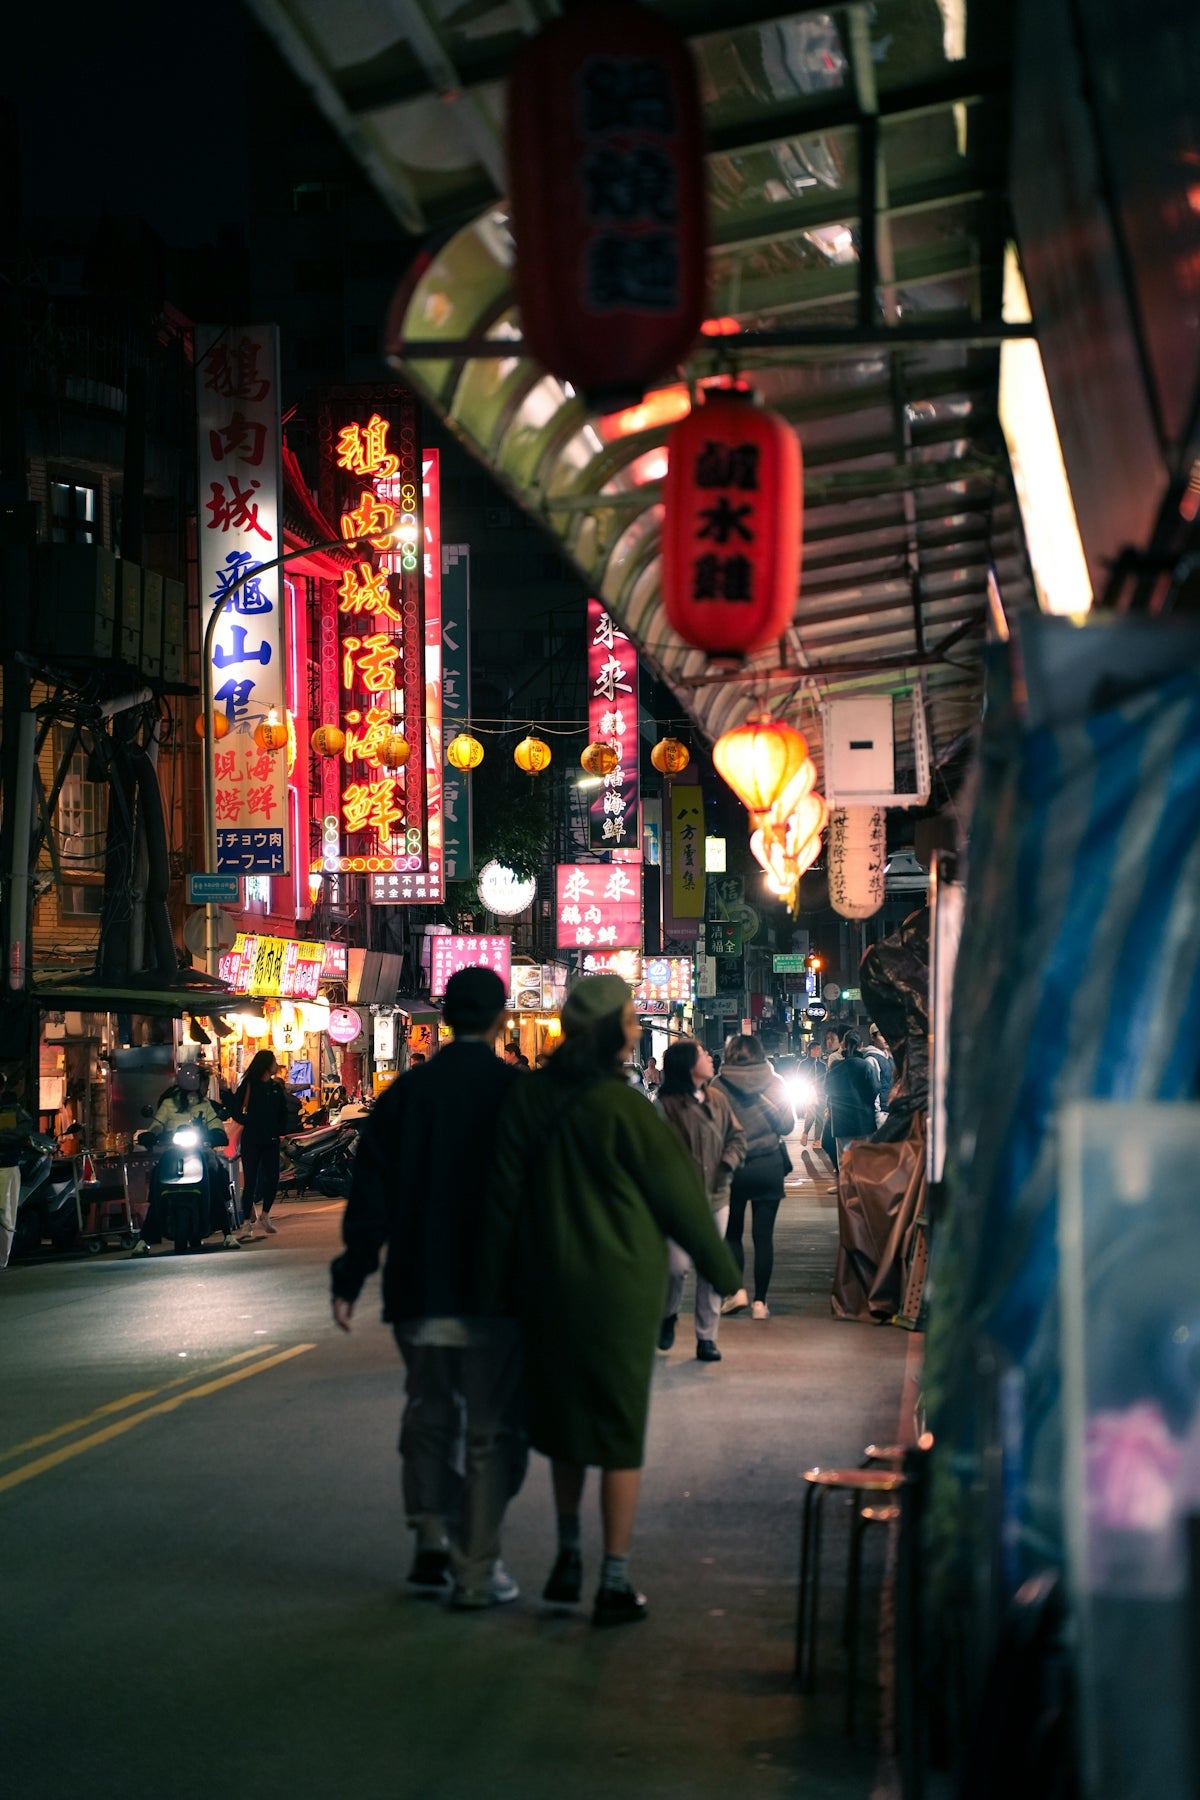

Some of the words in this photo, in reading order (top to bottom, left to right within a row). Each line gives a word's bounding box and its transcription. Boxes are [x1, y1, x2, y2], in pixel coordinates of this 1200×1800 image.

[337, 413, 402, 841] 鵝肉城活海鮮
[374, 875, 440, 886] 酒後不開車
[562, 866, 635, 903] 來來
[374, 888, 440, 899] 安全有保障
[575, 925, 618, 946] 海鮮
